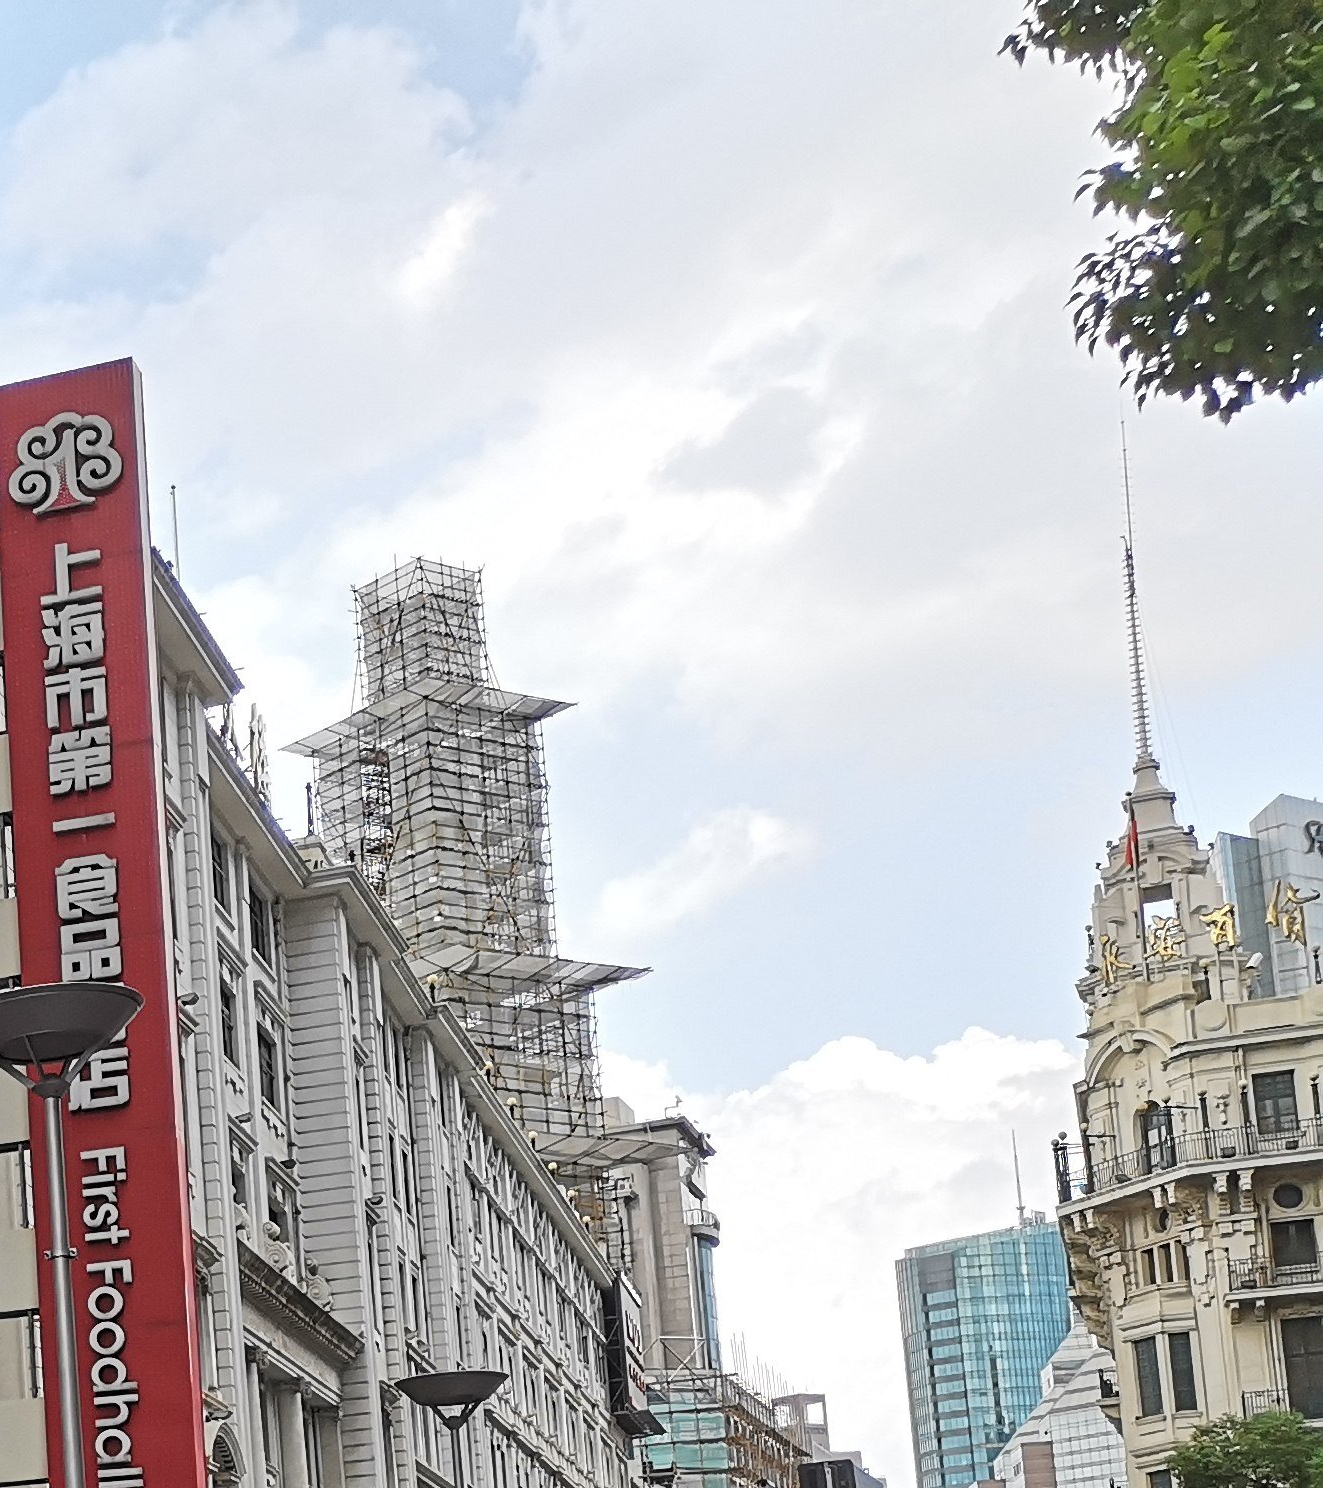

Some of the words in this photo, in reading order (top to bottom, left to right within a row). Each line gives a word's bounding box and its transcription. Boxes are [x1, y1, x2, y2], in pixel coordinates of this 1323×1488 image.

[40, 541, 131, 1113] 上海市第一食品店
[78, 1145, 131, 1246] First
